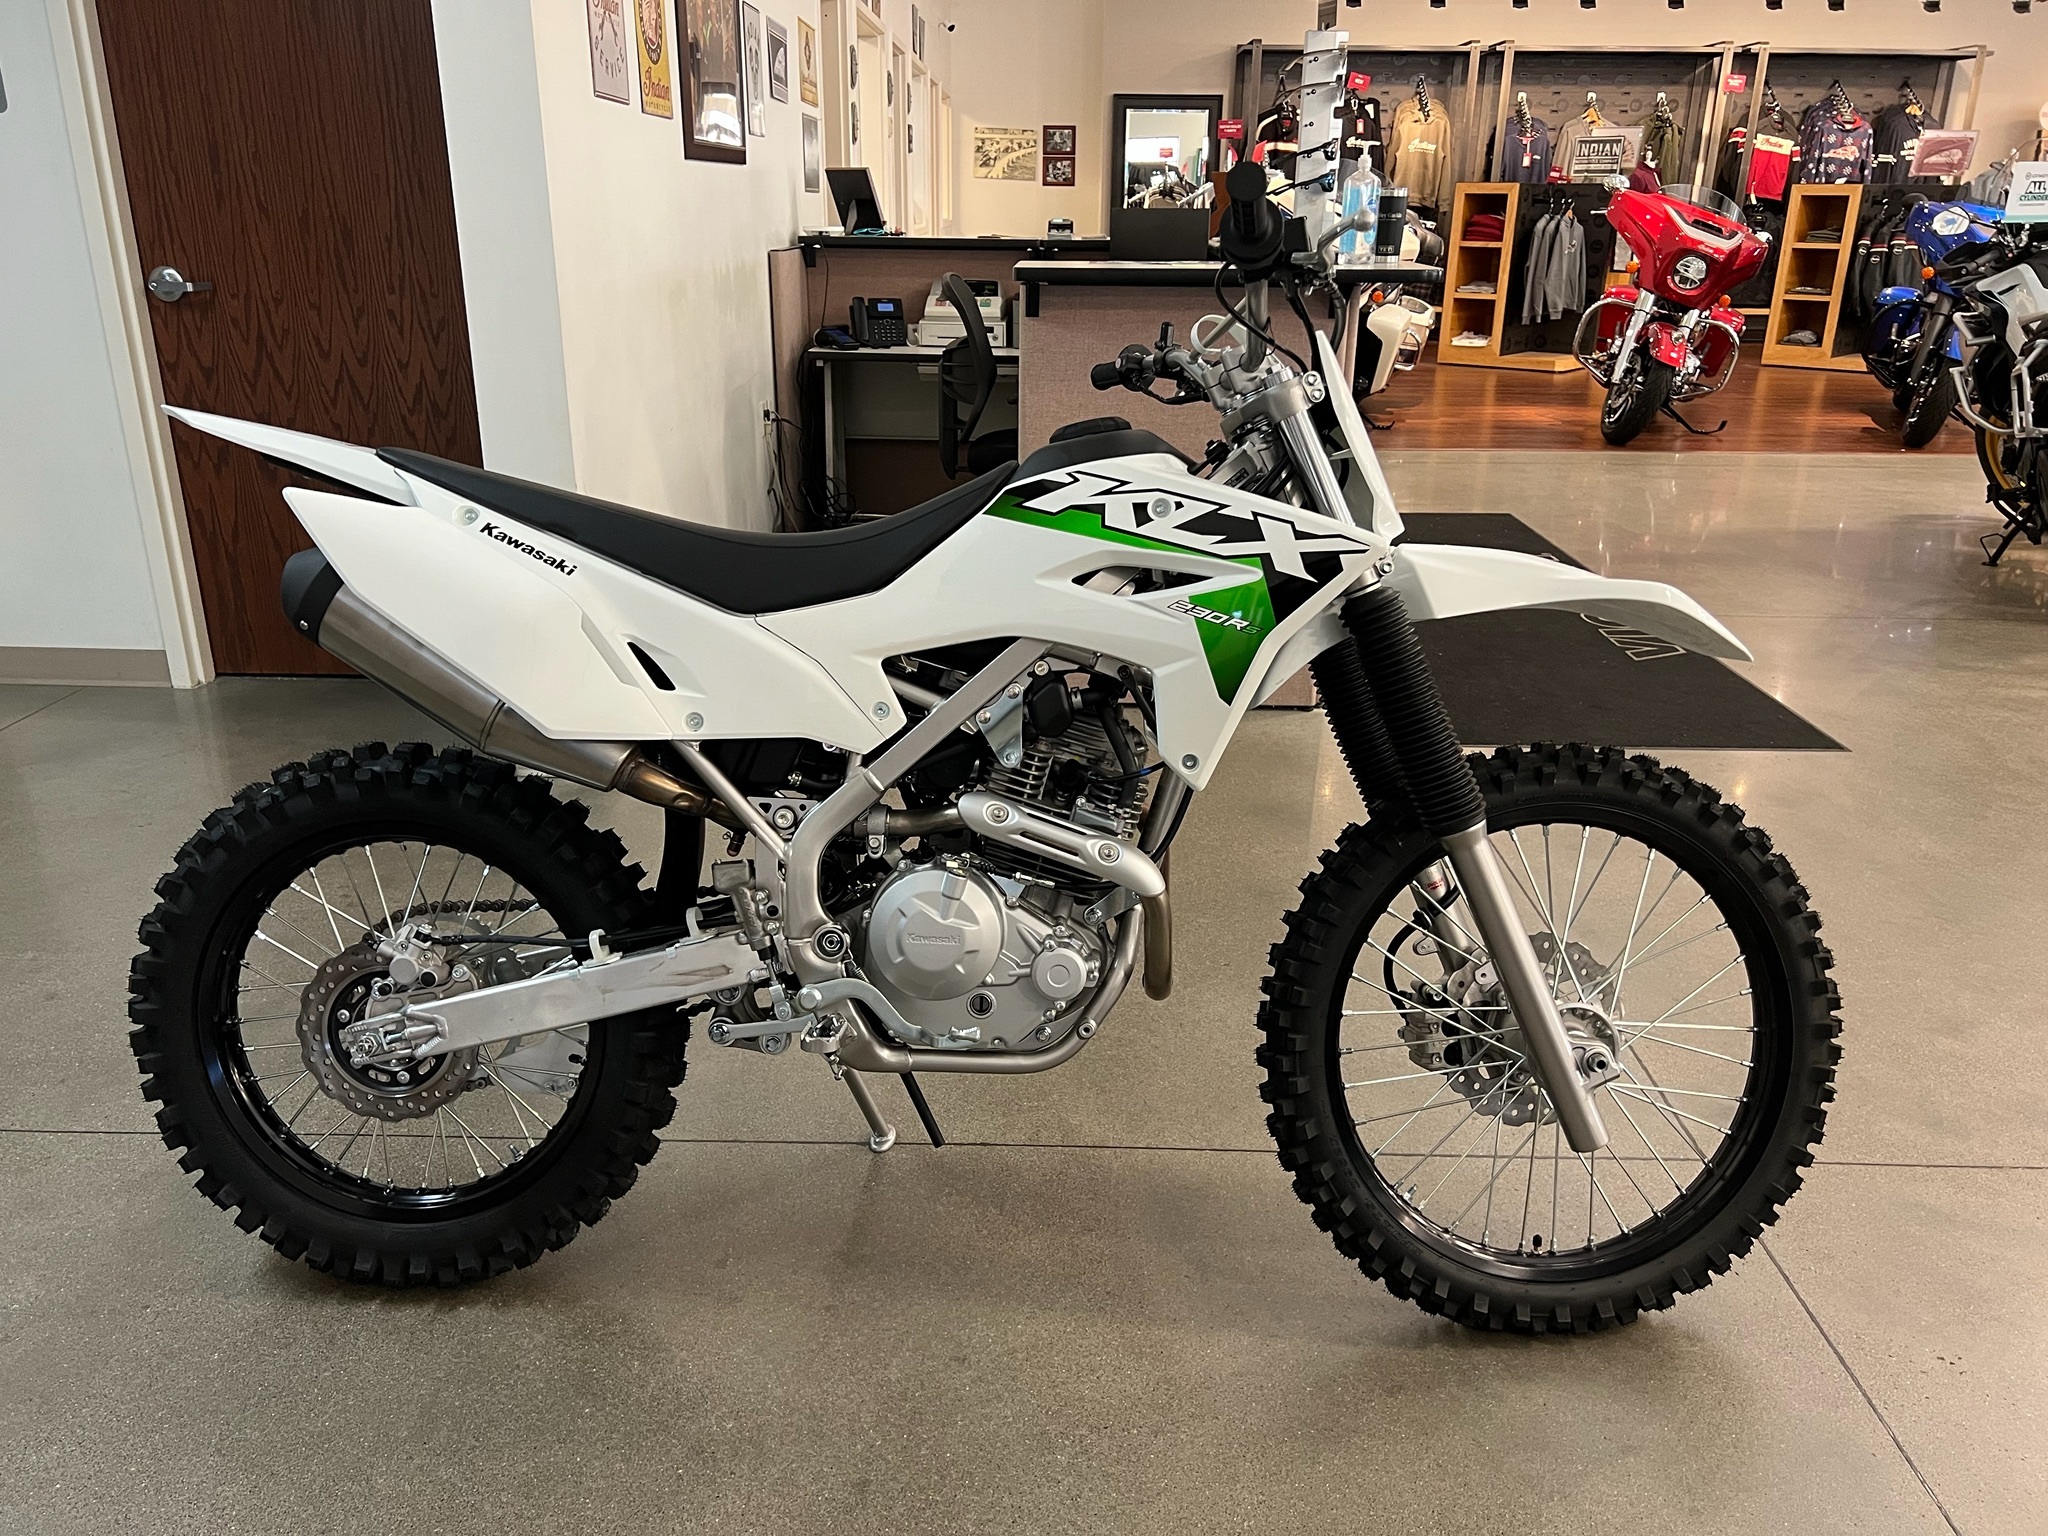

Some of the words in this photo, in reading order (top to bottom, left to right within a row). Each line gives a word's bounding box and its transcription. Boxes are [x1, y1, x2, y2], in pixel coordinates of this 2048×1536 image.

[643, 66, 671, 102] Indian
[1576, 142, 1621, 157] INDIAN
[2025, 181, 2046, 194] ALL
[1021, 470, 1372, 584] KLX
[479, 522, 578, 576] Kawasaki
[906, 932, 961, 946] Kawasaki
